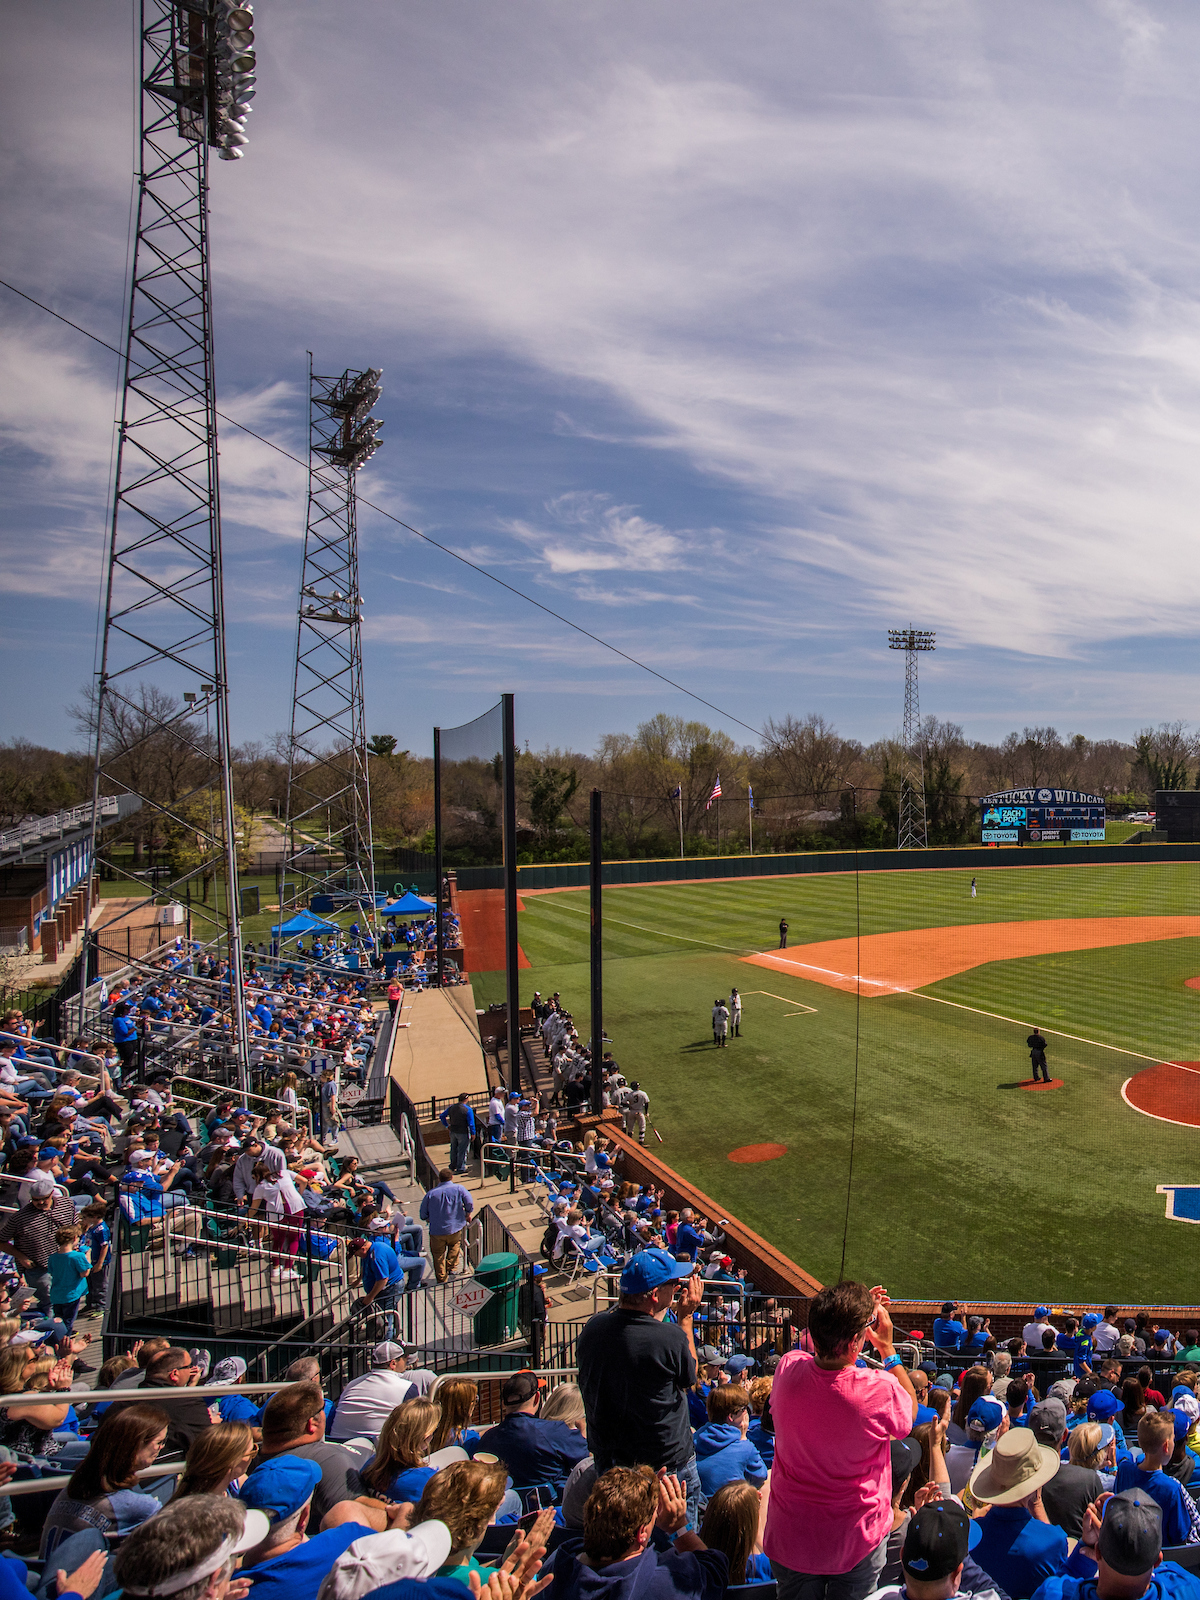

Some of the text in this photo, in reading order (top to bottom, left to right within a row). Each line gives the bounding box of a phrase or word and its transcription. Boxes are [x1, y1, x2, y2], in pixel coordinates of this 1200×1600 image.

[982, 789, 1105, 804] KENTUCKY WILDCATS
[1002, 809, 1022, 817] ZACH
[310, 1058, 328, 1075] H
[342, 1089, 362, 1098] EXIT
[633, 1095, 639, 1104] 3
[455, 1288, 487, 1305] EXIT
